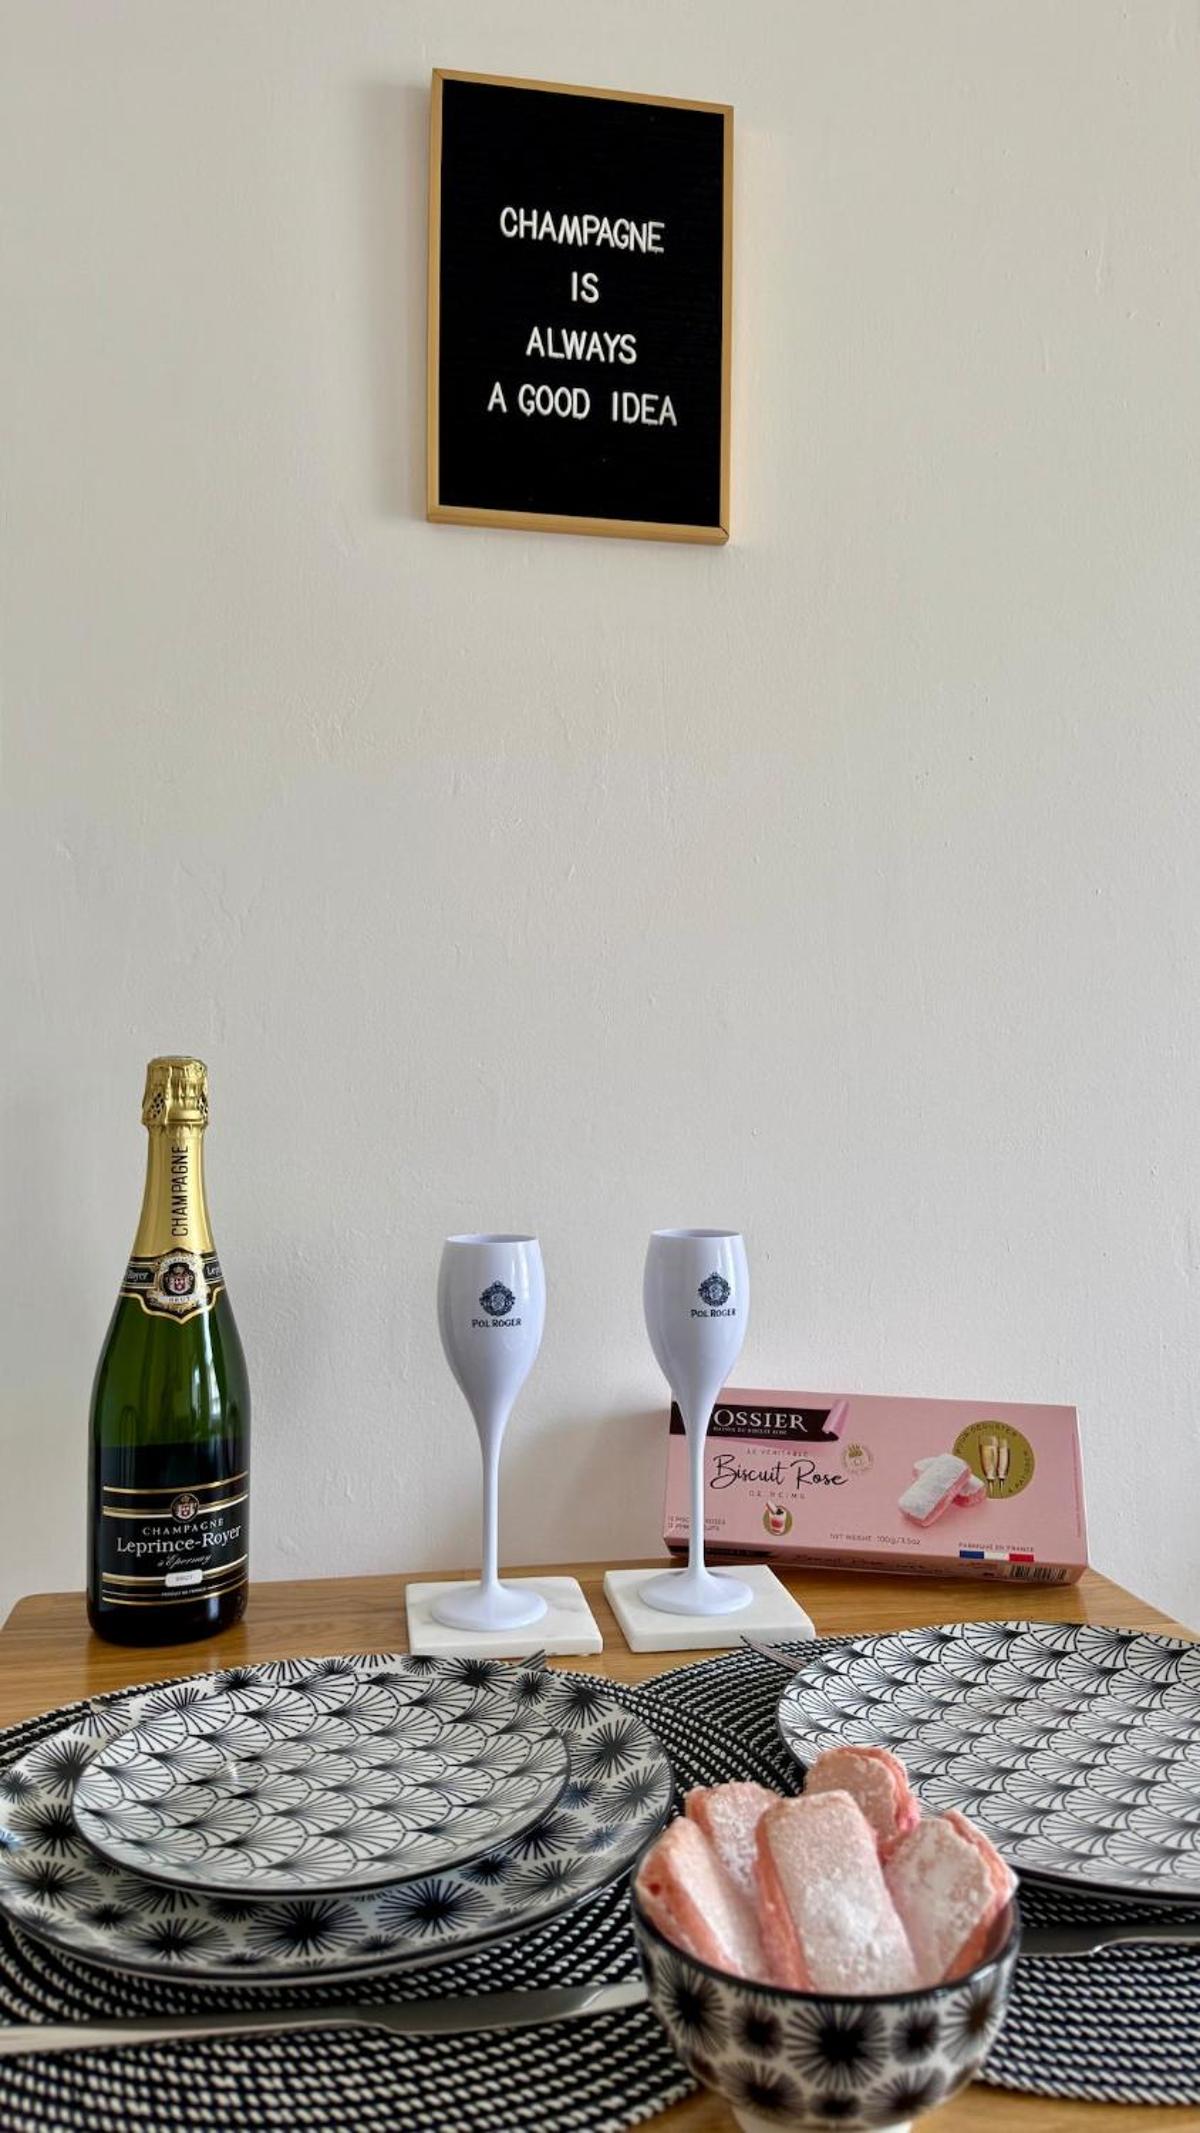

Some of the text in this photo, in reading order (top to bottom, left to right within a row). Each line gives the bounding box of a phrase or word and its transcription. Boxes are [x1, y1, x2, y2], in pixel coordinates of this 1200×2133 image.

[500, 206, 665, 254] CHAMPAGNE
[571, 271, 600, 303] IS
[526, 326, 638, 364] ALWAYS
[487, 381, 678, 427] A GOOD IDEA
[171, 1146, 189, 1237] CHAMPAGNE
[471, 1318, 522, 1328] POL ROGER
[713, 1408, 808, 1433] OSSIER
[710, 1454, 848, 1490] Biscuit Rose
[116, 1525, 242, 1557] Leprince-Royer
[142, 1518, 225, 1536] CHAMPAGNE
